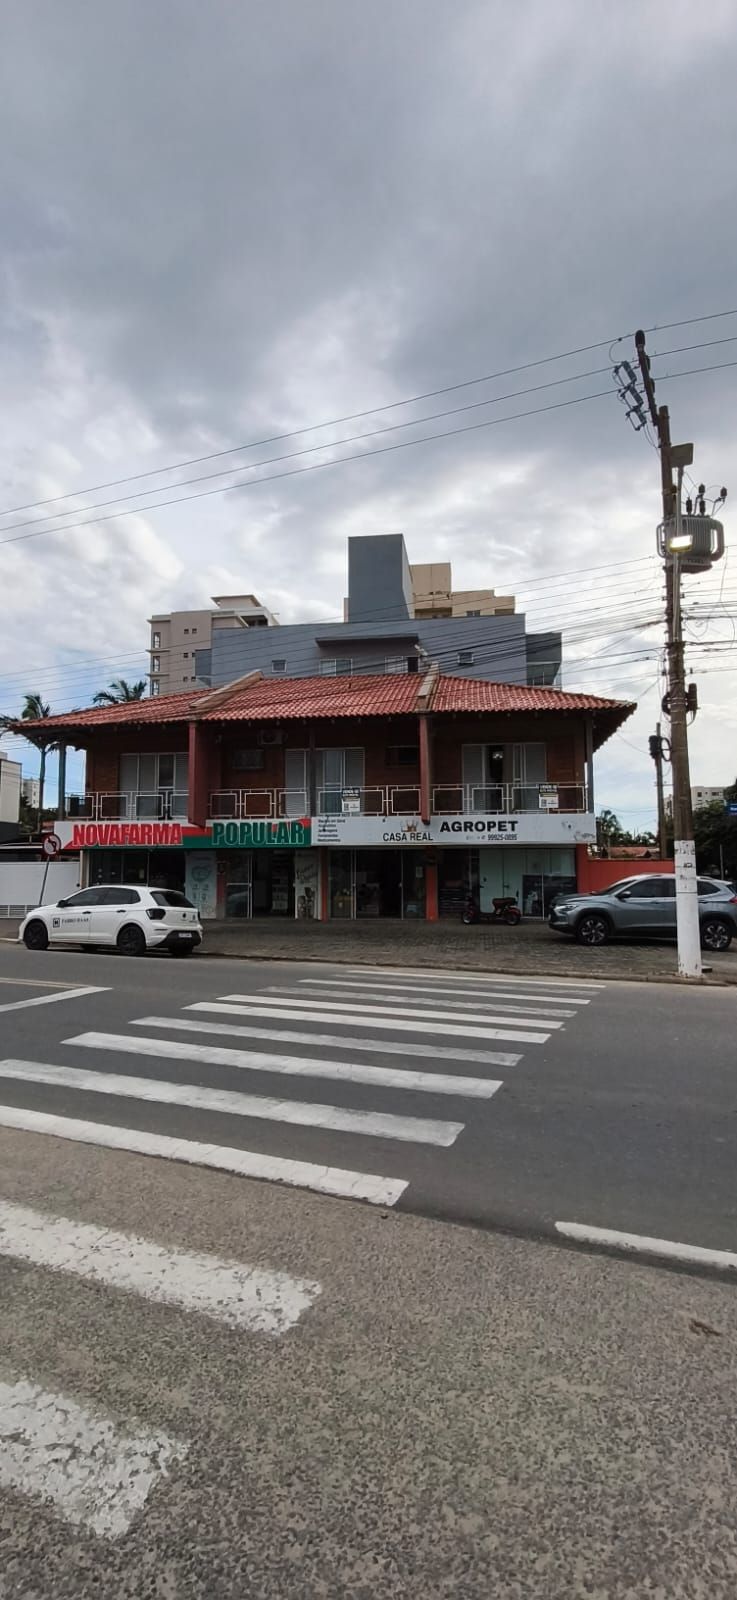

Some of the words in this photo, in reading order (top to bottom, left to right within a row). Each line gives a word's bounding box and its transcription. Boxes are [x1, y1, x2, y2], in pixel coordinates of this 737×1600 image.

[439, 820, 519, 833] AGROPET
[72, 823, 183, 847] NOVAFARMA
[211, 821, 305, 846] POPULAR
[382, 832, 408, 842] CASA
[410, 832, 434, 841] REAL
